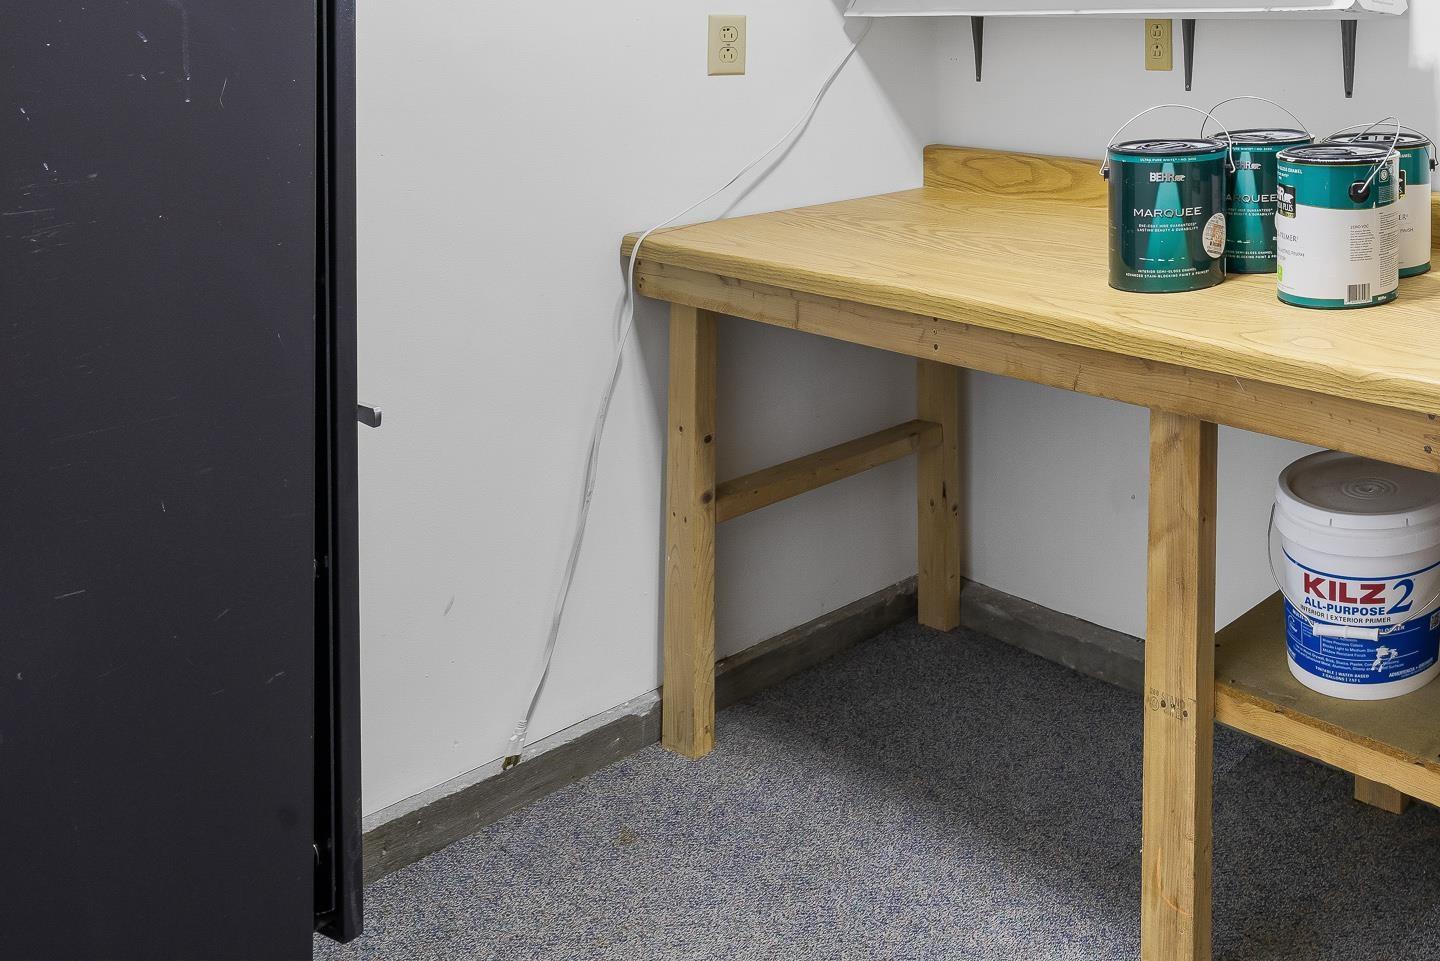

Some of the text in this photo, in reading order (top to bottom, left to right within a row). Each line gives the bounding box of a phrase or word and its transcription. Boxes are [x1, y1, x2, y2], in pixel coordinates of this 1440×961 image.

[1149, 172, 1175, 182] BEHR
[1133, 207, 1203, 218] MARQUEE
[1303, 572, 1416, 615] KILZ 2
[1300, 604, 1325, 620] INTERIOR
[1329, 614, 1365, 624] EXTERIOR
[1365, 616, 1391, 624] PRIMER
[1304, 596, 1386, 616] ALL-PURPOSE
